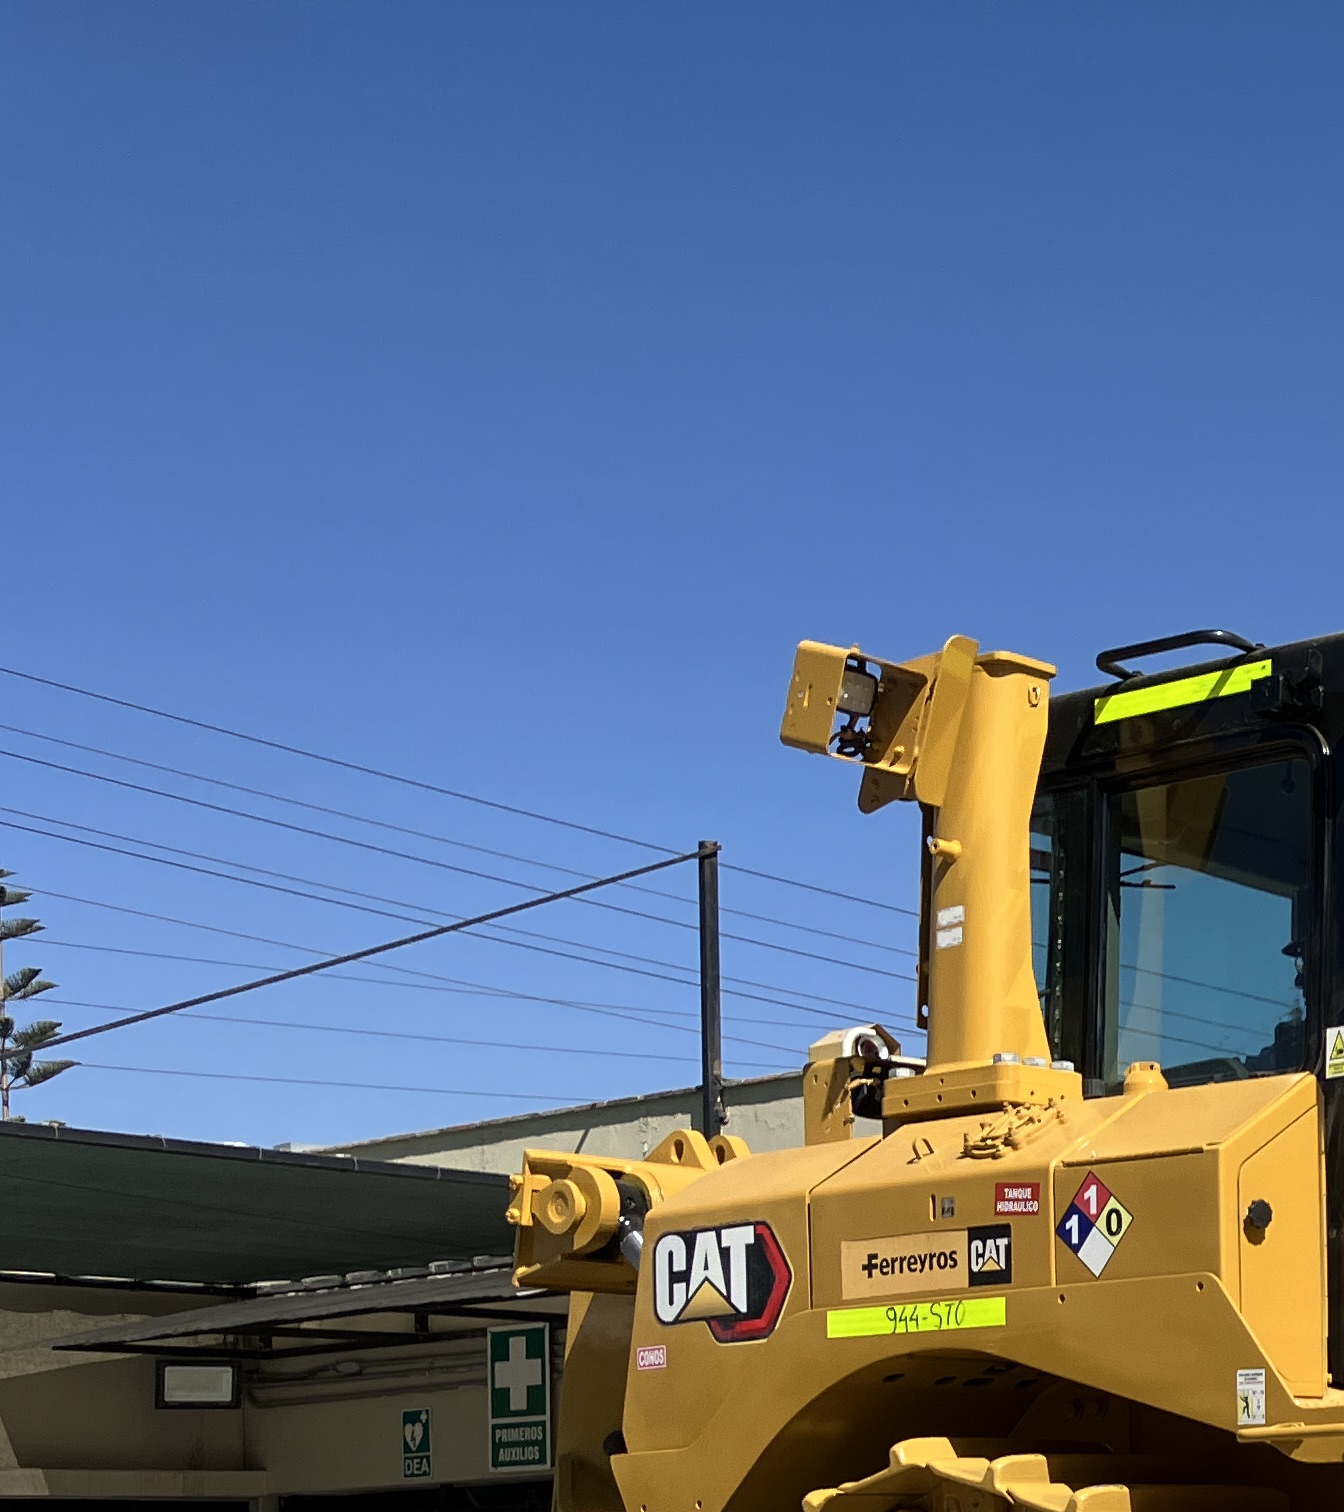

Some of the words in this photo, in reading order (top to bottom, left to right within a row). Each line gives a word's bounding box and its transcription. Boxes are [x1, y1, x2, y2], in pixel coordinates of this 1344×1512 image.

[1004, 1187, 1032, 1199] TANQUE
[1084, 1184, 1097, 1215] 1
[1065, 1214, 1079, 1244] 1
[1105, 1208, 1123, 1236] 0
[861, 1250, 958, 1279] Ferreyros
[970, 1237, 1009, 1273] CAT
[655, 1225, 755, 1323] CAT
[495, 1426, 543, 1443] PRIMEROS
[404, 1458, 430, 1475] DEA
[498, 1446, 540, 1462] AUXILIOS
